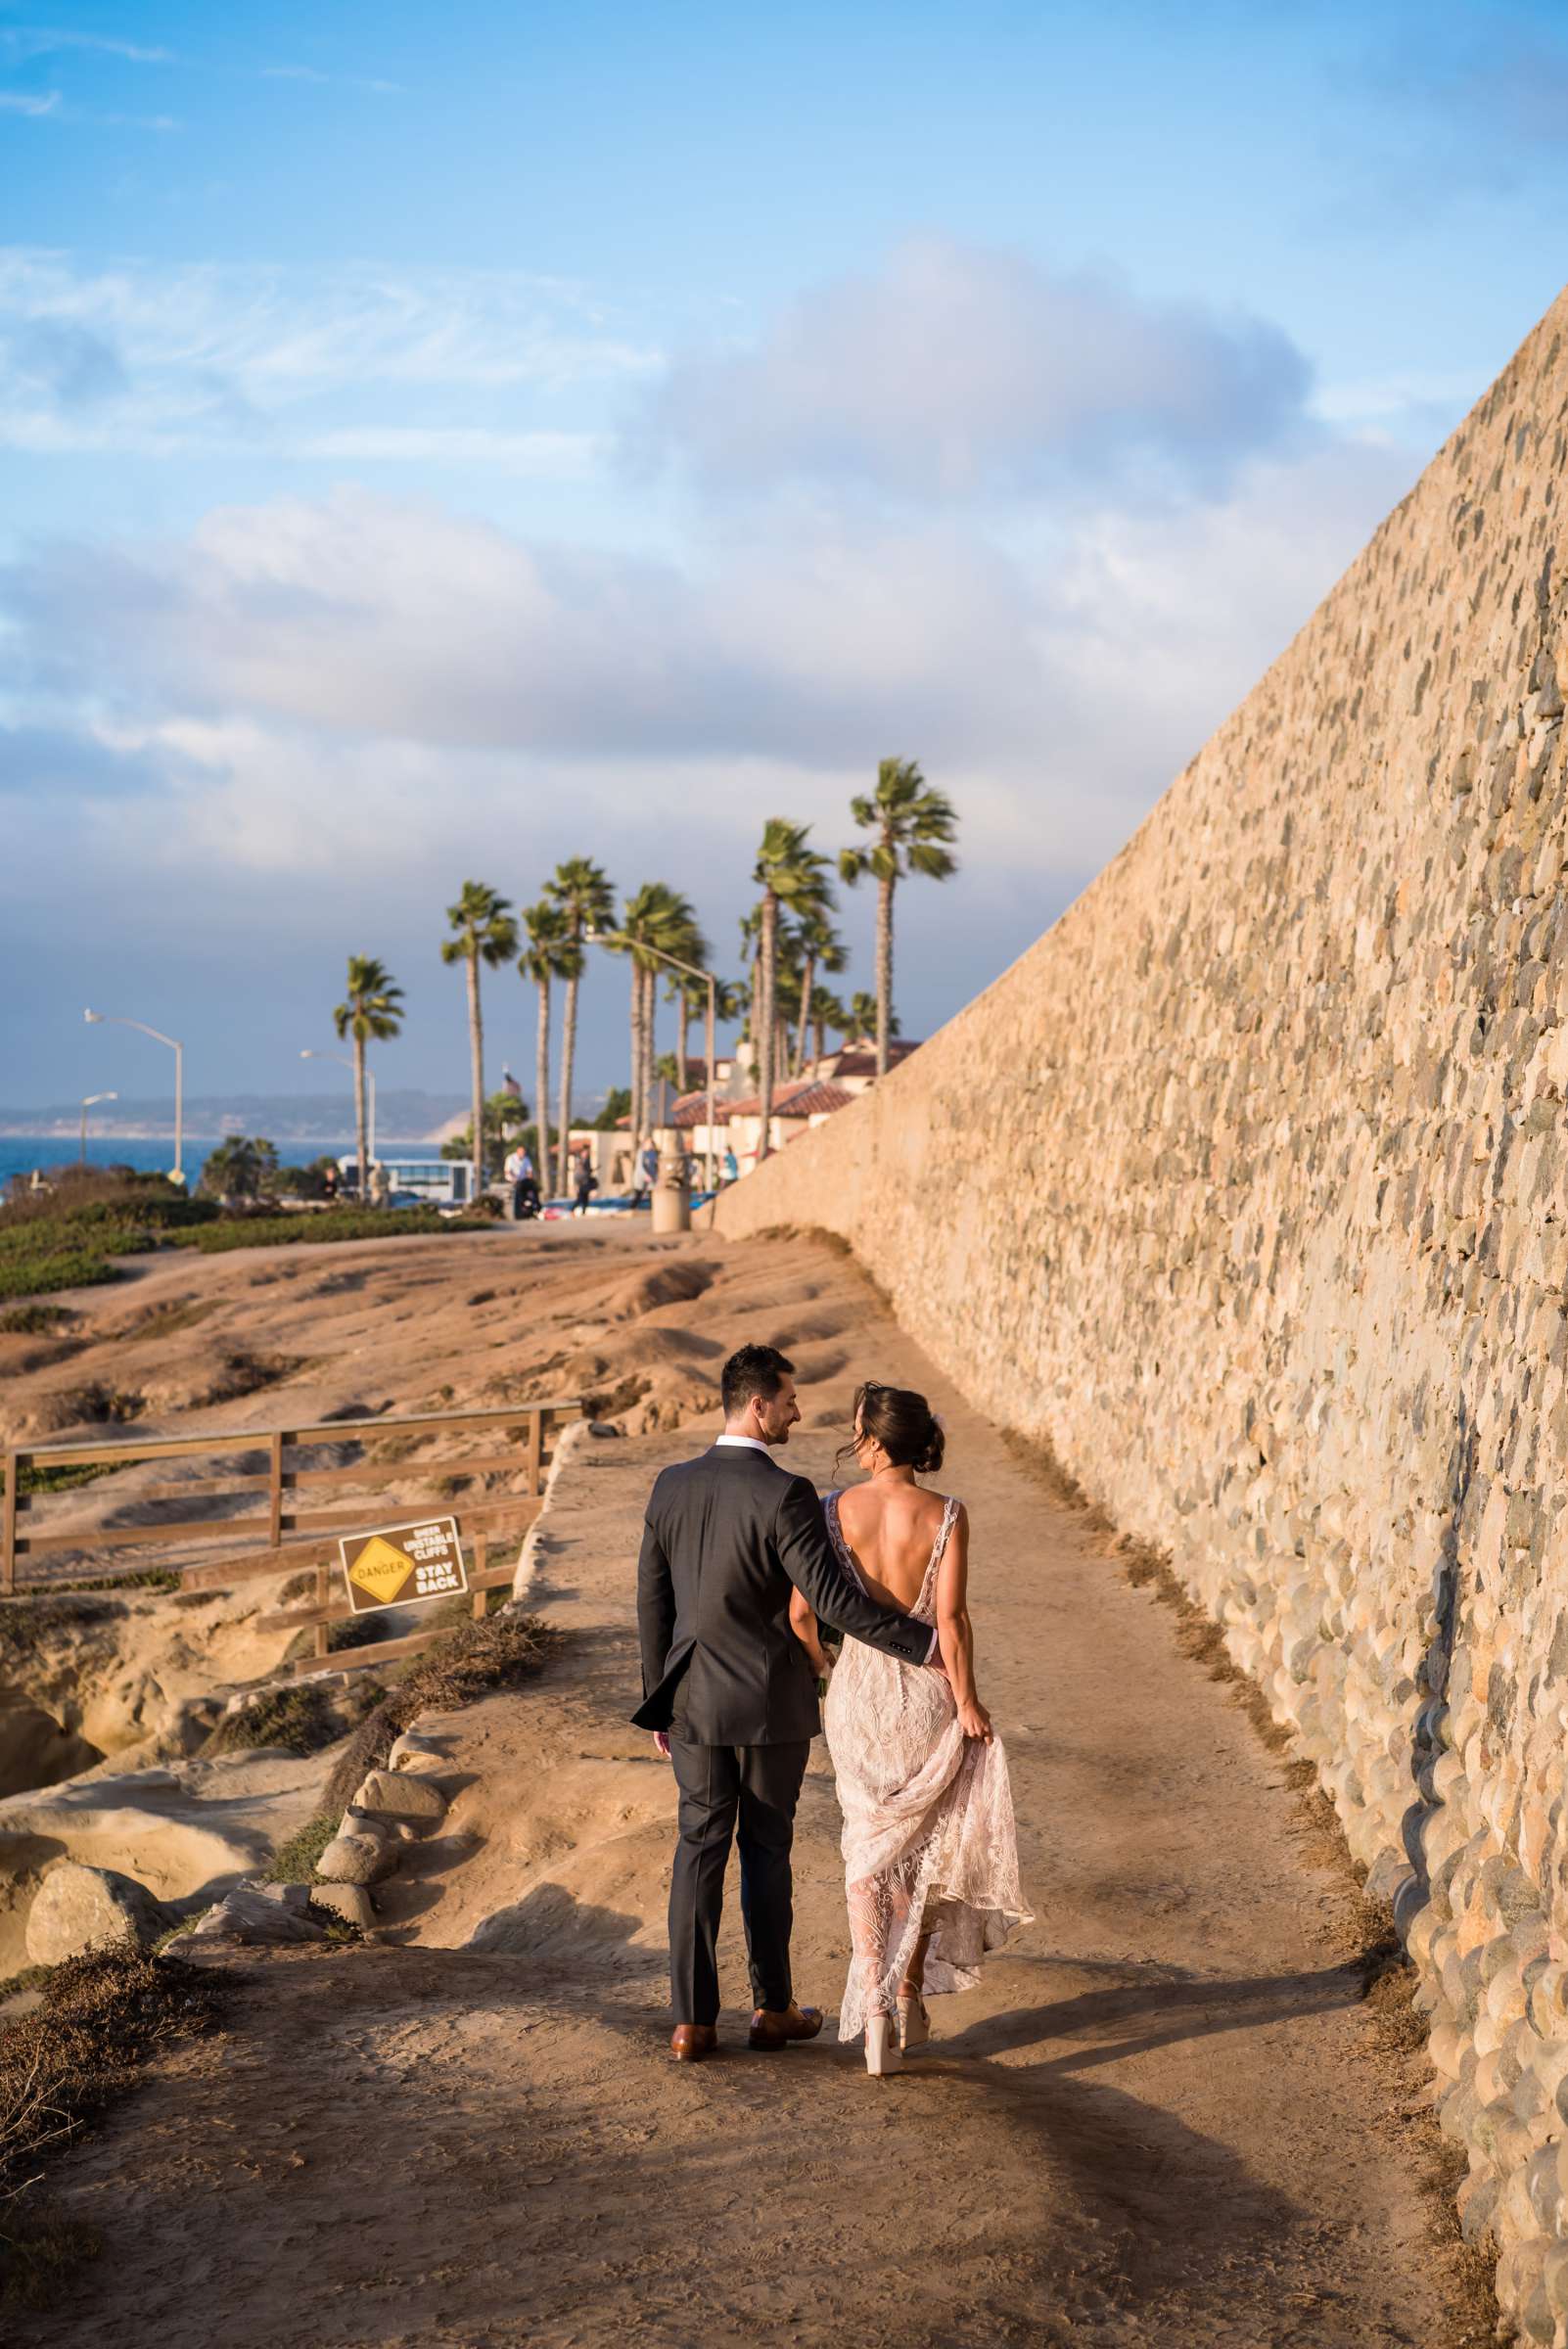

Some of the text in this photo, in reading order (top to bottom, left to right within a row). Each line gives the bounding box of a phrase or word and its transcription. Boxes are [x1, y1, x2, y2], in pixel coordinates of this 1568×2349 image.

[402, 1532, 454, 1551] UNSTABLE
[414, 1544, 448, 1560] CLIFFS
[358, 1560, 405, 1580] DANGER
[416, 1562, 453, 1581] STAY
[416, 1574, 459, 1594] BACK
